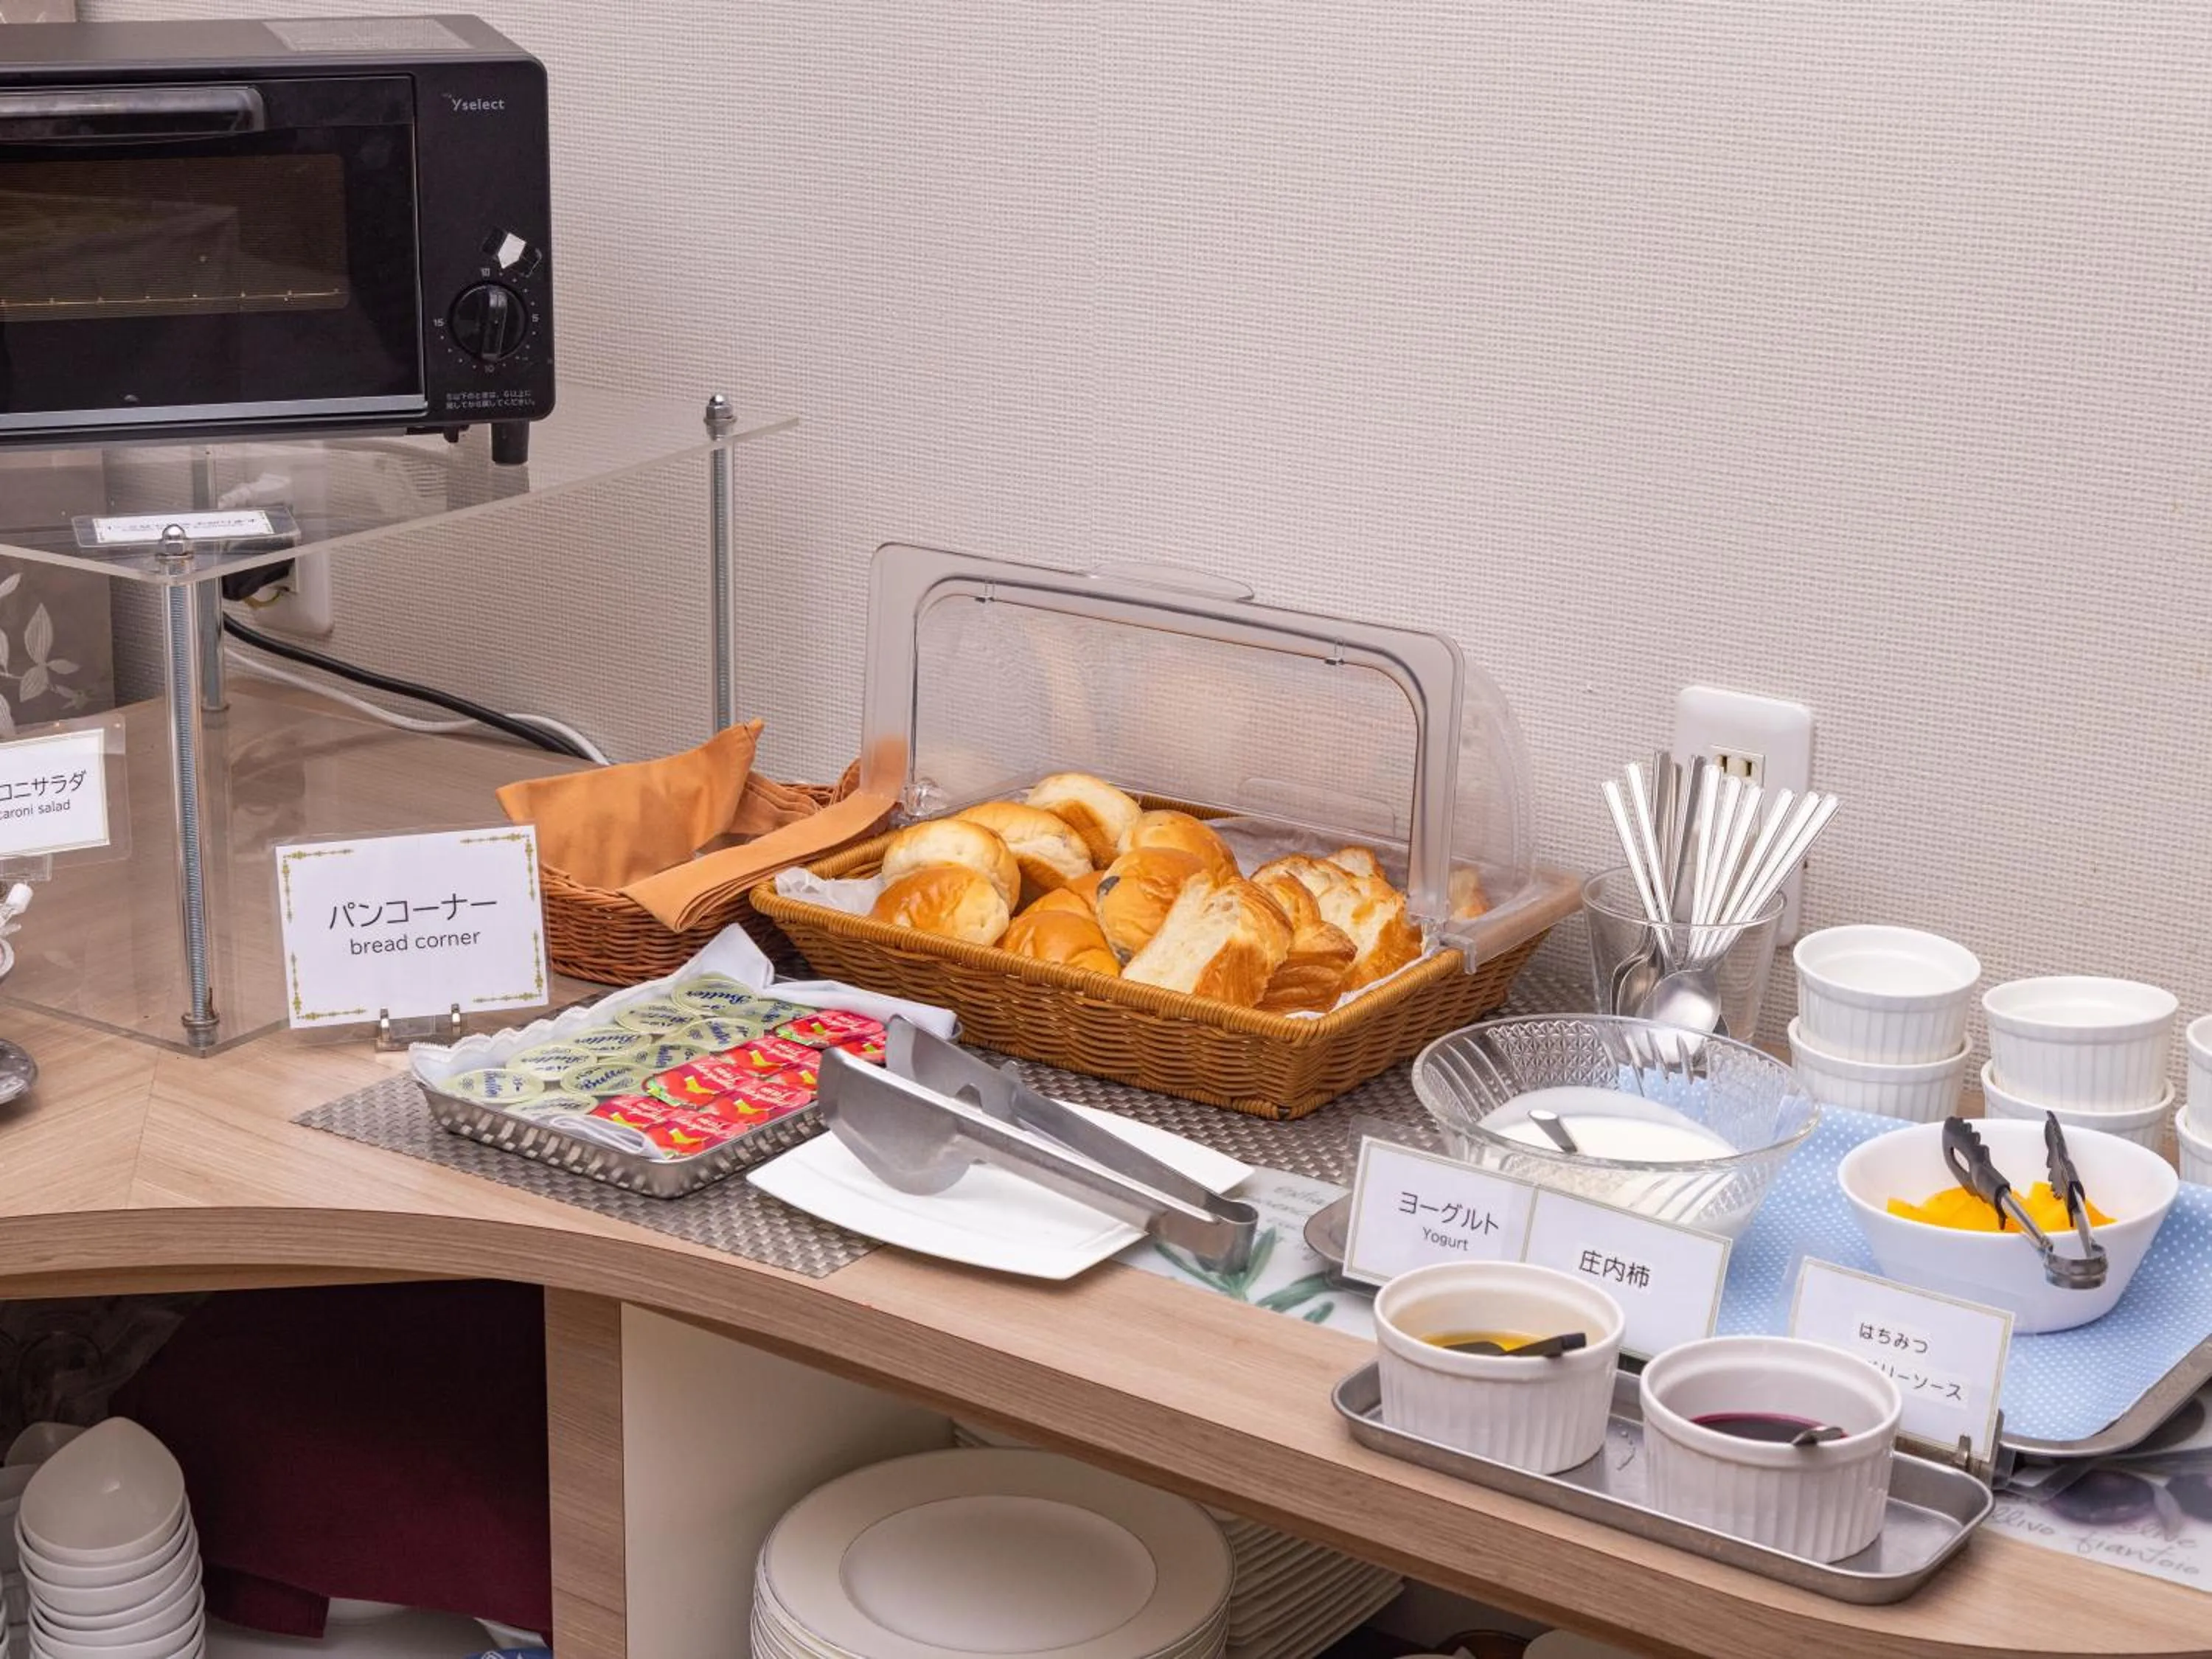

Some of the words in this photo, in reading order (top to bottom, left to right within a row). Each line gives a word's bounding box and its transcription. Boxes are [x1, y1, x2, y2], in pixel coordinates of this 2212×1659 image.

[451, 98, 505, 111] Yselect
[434, 318, 445, 327] 15
[0, 770, 87, 801] コニサラダ
[0, 804, 33, 820] aroni
[38, 799, 70, 814] salad
[330, 893, 498, 929] パンコーナー
[350, 934, 408, 955] bread
[414, 931, 481, 950] corner
[1399, 1192, 1499, 1235] ヨーグルト
[1422, 1226, 1469, 1251] Yogurt
[1579, 1251, 1650, 1288] 庄内柿
[1860, 1323, 1928, 1354] はちみつ
[1868, 1360, 1961, 1401] リーソース
